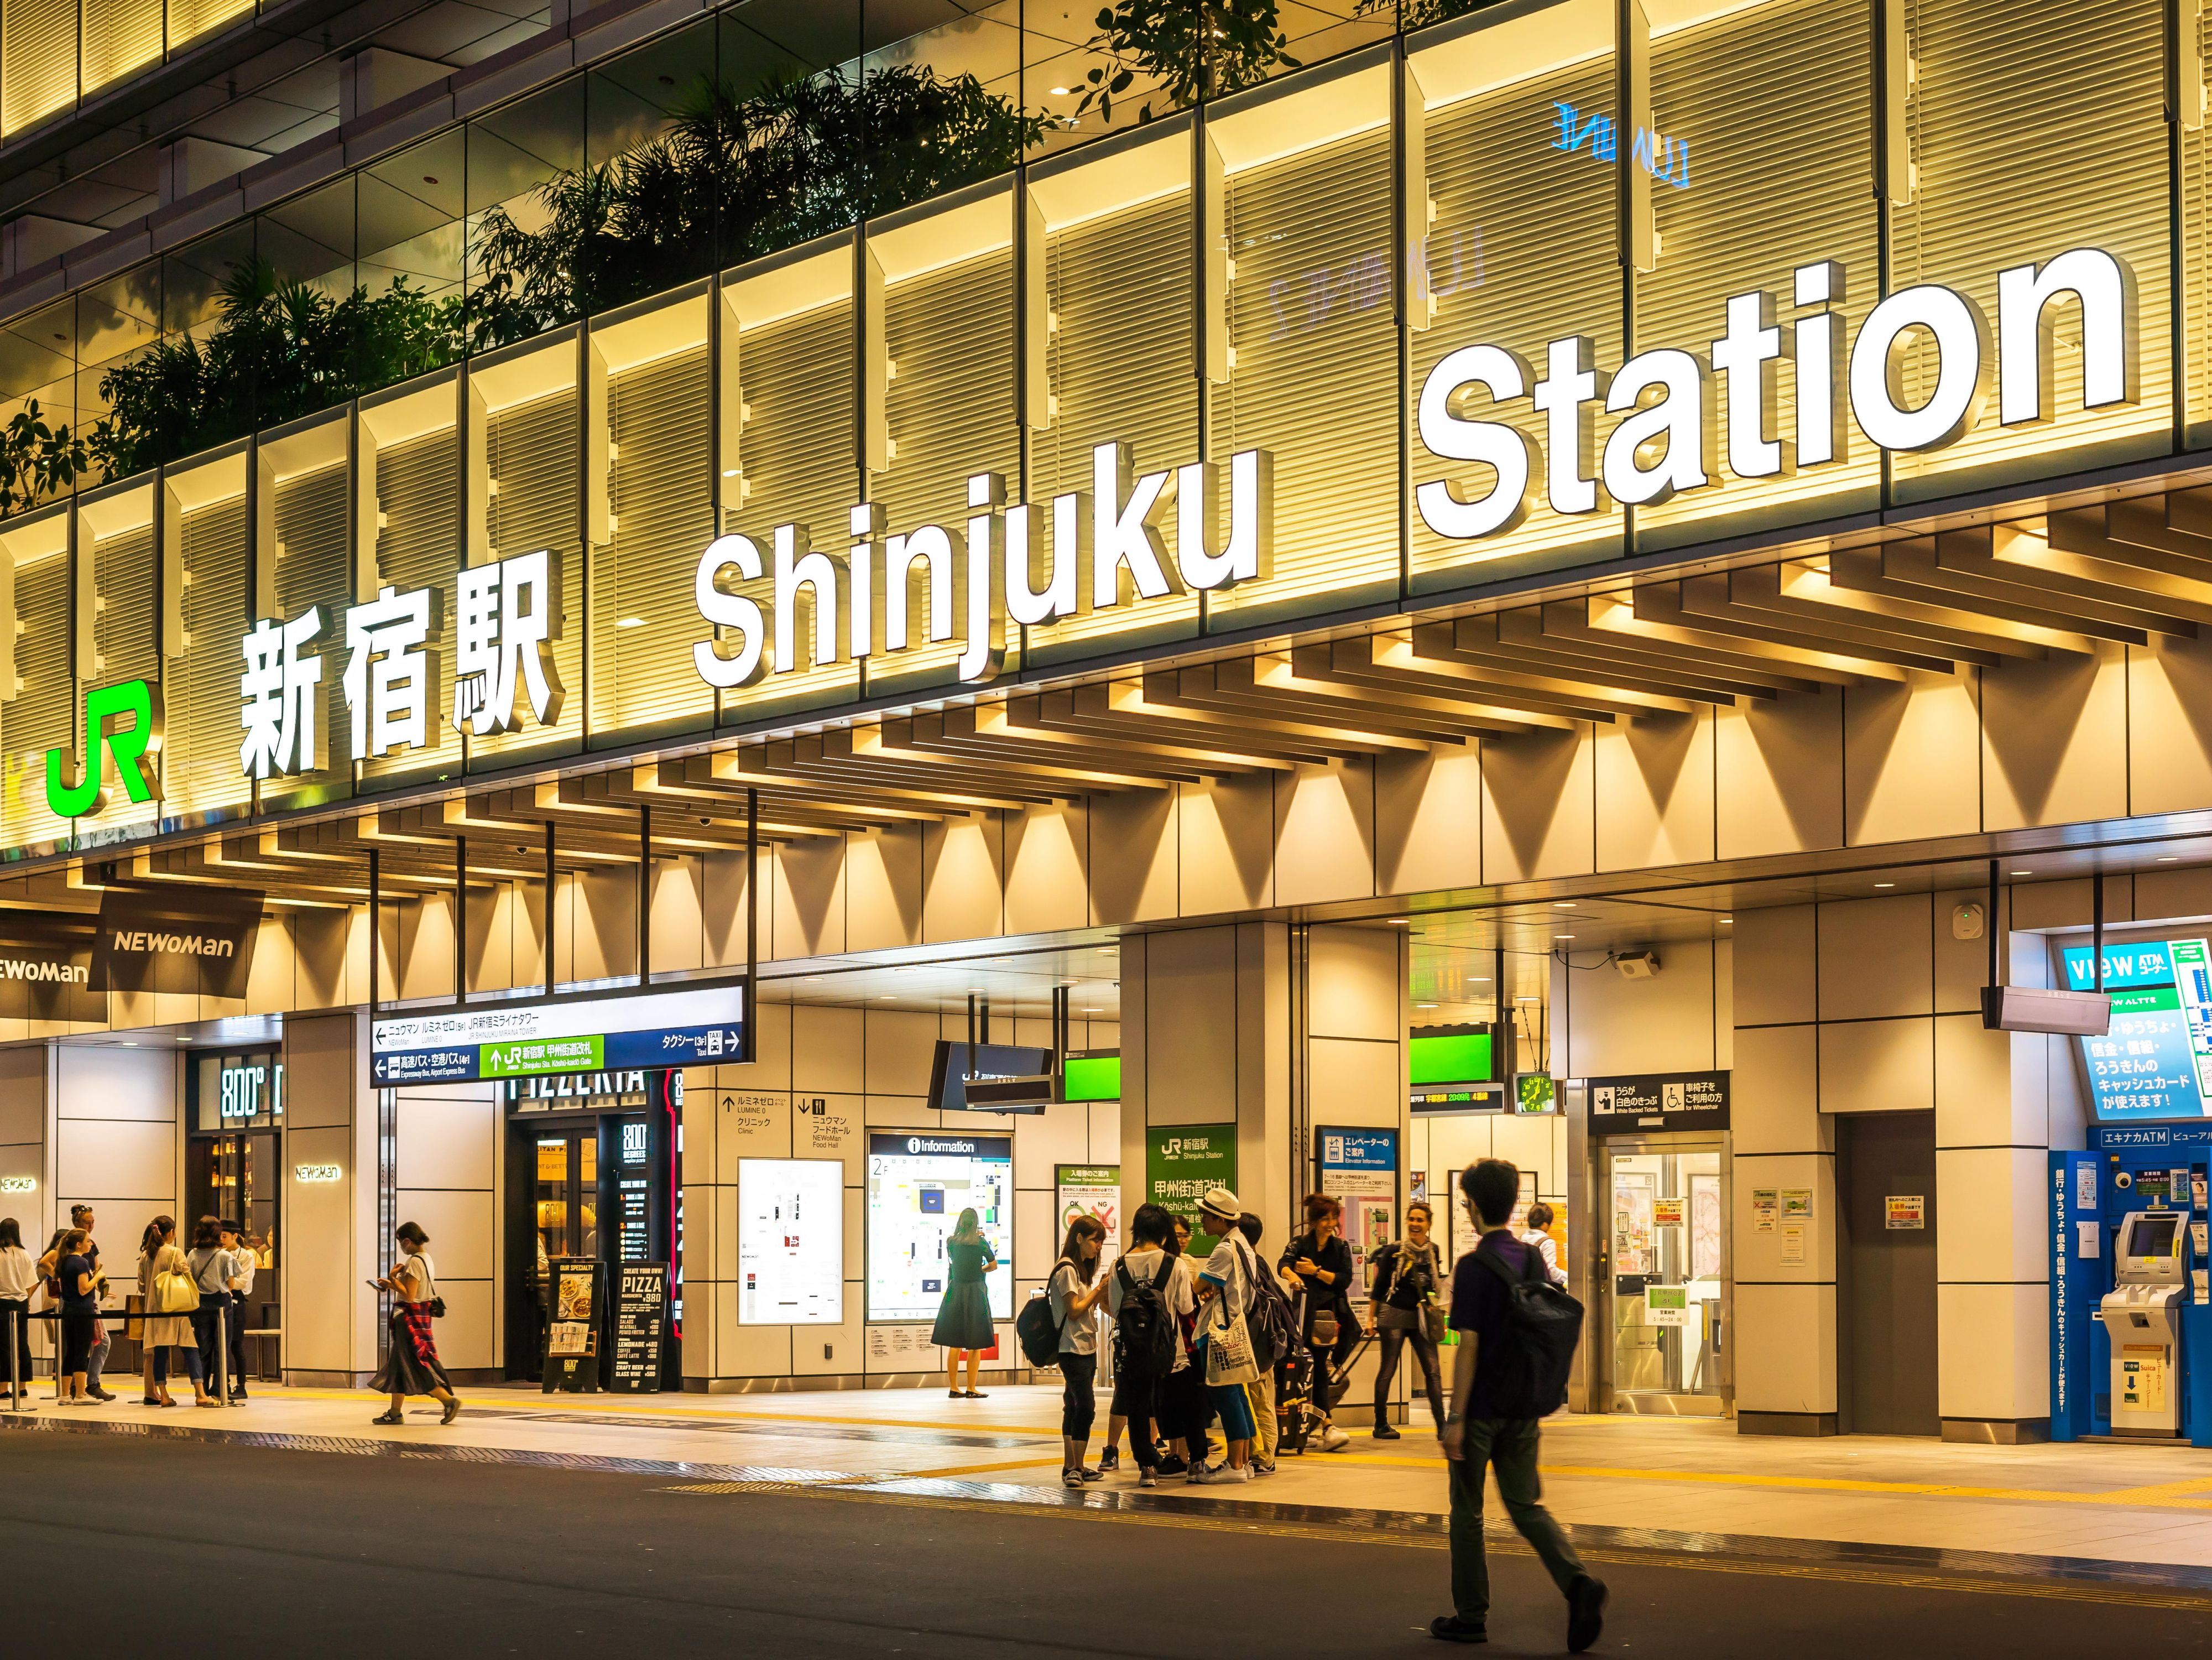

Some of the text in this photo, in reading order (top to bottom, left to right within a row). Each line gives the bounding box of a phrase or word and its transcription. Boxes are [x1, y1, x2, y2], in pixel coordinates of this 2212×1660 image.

[46, 247, 2129, 817] JR 新宿駅 Shinjuku Station
[2138, 954, 2164, 966] ATM
[2140, 964, 2168, 975] コーナー
[389, 1024, 418, 1036] ニュウマン
[475, 1030, 498, 1039] SHINJUKU
[499, 1028, 518, 1037] MIRAINA
[504, 1041, 592, 1065] JR 新宿駅 甲州街道改札
[522, 1061, 541, 1070] Shinjuku
[2094, 1059, 2158, 1075] ろうきんの
[401, 1070, 421, 1079] Expressway
[430, 1068, 443, 1076] Airport
[443, 1068, 457, 1076] Express
[1686, 1082, 1715, 1092] 車椅子を
[2099, 1075, 2190, 1092] キャッシュカード
[1616, 1086, 1636, 1096] うらが
[737, 1096, 774, 1106] ルミネゼロ
[1616, 1095, 1658, 1107] 白色のきっぷ
[1686, 1092, 1723, 1104] ご利用の方
[737, 1117, 770, 1127] クリニック
[812, 1116, 847, 1125] ニュウマン
[813, 1126, 851, 1135] フードホール
[1345, 1137, 1389, 1147] エレベーターの
[2105, 1130, 2166, 1144] エキナカATM
[921, 1139, 974, 1153] Information
[1162, 1138, 1208, 1154] JR 新宿駅
[1183, 1152, 1205, 1161] Shinjuku
[1345, 1148, 1364, 1157] ご案内
[622, 1277, 662, 1293] PIZZA
